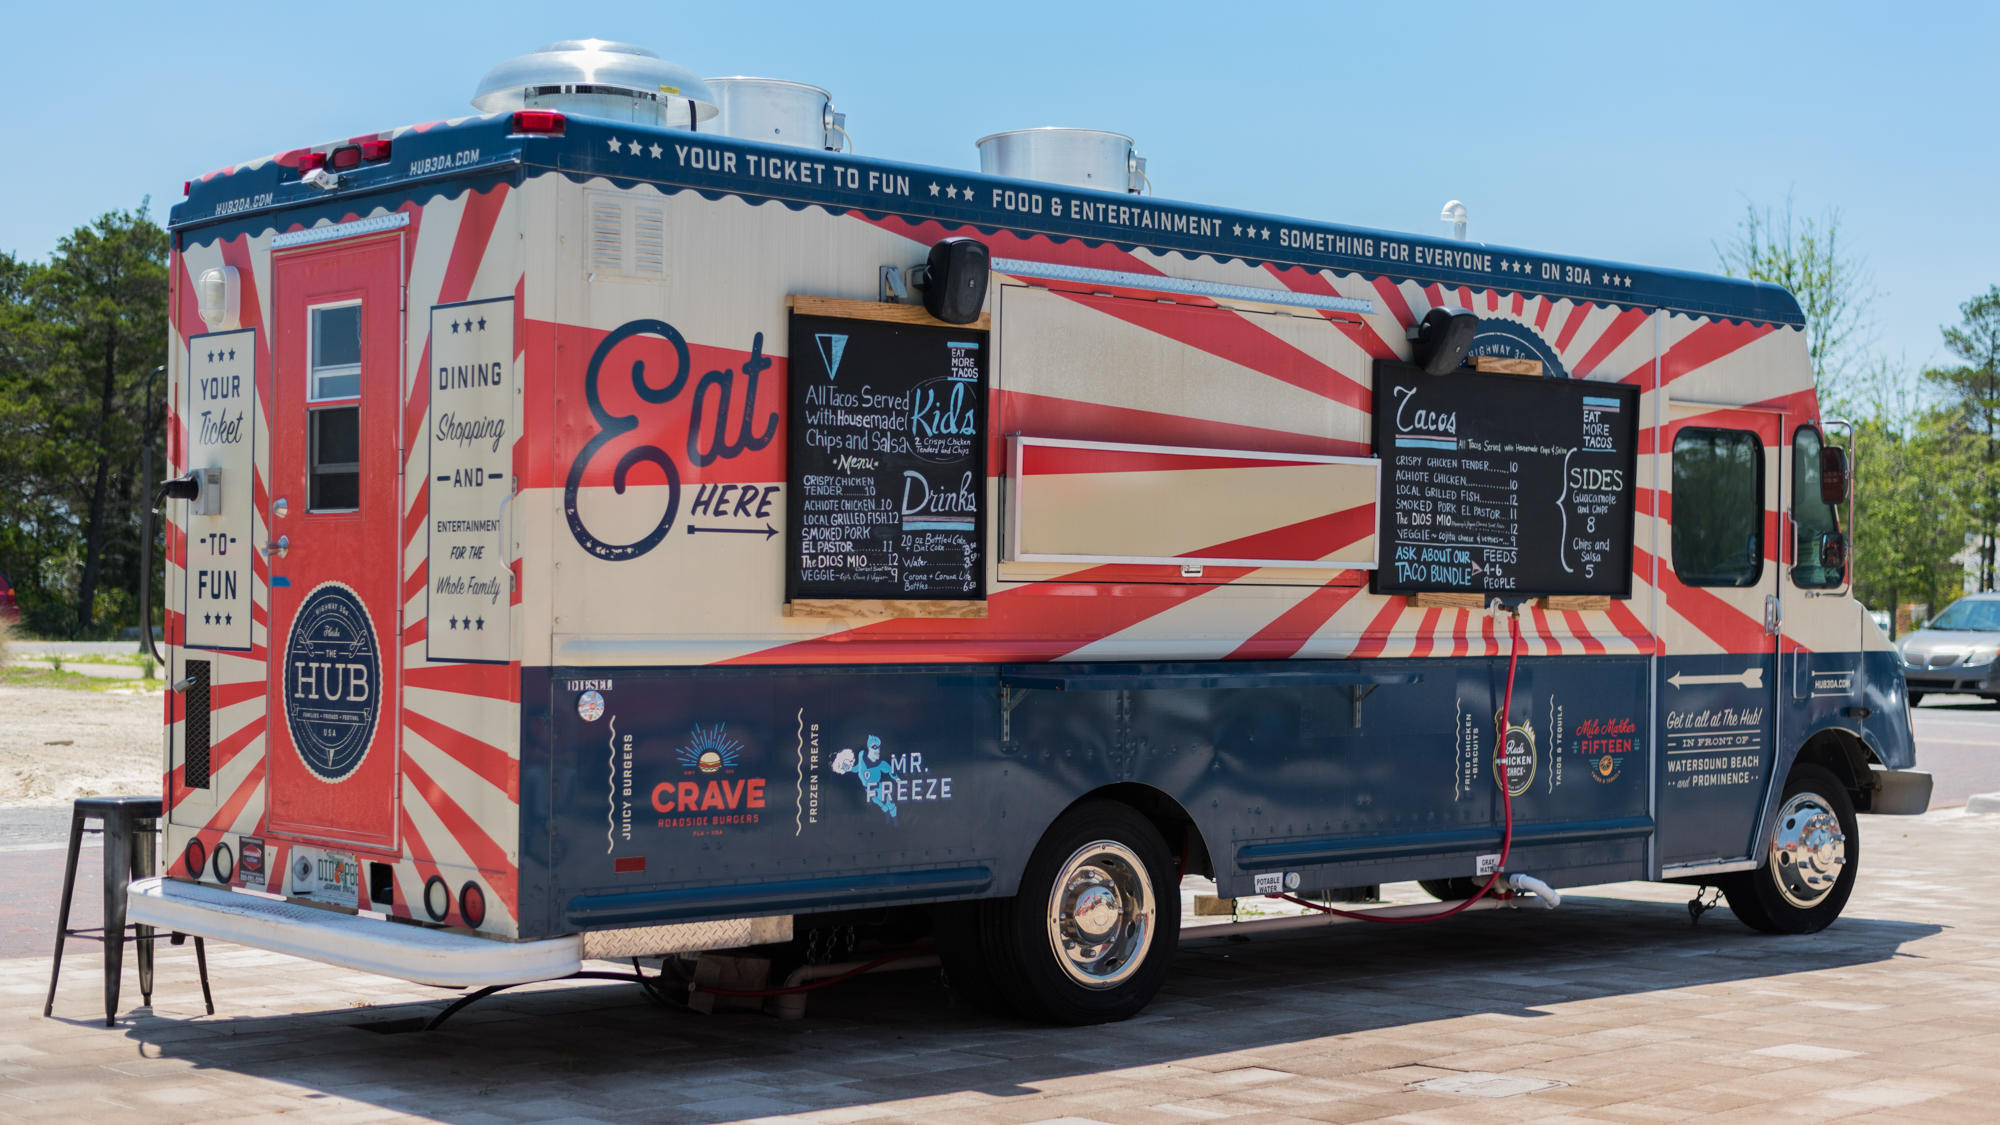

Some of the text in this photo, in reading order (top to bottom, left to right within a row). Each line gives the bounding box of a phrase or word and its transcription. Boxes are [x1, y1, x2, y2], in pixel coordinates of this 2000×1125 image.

[674, 144, 909, 196] YOUR TICKET TO FUN
[992, 188, 1223, 237] FOOD & ENTERTAINMENT
[1279, 228, 1492, 272] SOMETHING FOR EVERYONE
[1542, 262, 1592, 285] ON 30A
[951, 348, 965, 357] EAT
[951, 358, 974, 367] MORE
[439, 362, 502, 390] DINING
[951, 367, 978, 379] TACOS
[200, 375, 240, 400] YOUR
[805, 384, 909, 410] All Tacos Served
[911, 382, 977, 437] Kids
[1394, 385, 1456, 434] Tacos
[1583, 411, 1601, 423] EAT
[199, 408, 244, 445] Ticket
[837, 409, 905, 431] Housemade
[436, 411, 505, 452] Shopping
[1583, 424, 1610, 436] MORE
[564, 319, 779, 562] Eat
[806, 428, 906, 454] Chips and Salsa
[1583, 436, 1613, 449] TACOS
[838, 454, 875, 475] Menu
[1395, 456, 1518, 473] CRISPY CHICKEN TENDER 10
[454, 467, 484, 488] AND
[803, 475, 874, 486] CRISPY CHICKEN
[1395, 470, 1518, 490] ACHIOTE CHICKEN 10
[1569, 467, 1623, 491] SIDES
[803, 486, 876, 496] TENDER 10
[902, 470, 977, 515] Drinks
[1396, 485, 1518, 506] LOCAL GRILLED FISH 12
[1572, 490, 1616, 505] Guacamole
[690, 484, 781, 518] HERE
[804, 499, 892, 511] ACHIOTE CHICKEN 10
[1577, 504, 1589, 514] and
[1395, 500, 1501, 520] SMOKED PORK EL PASTOR
[437, 519, 500, 533] ENTERTAINMENT
[804, 512, 899, 526] LOCAL GRILLED FISH 12
[1396, 512, 1408, 526] The
[1412, 513, 1432, 526] DIOS
[1436, 515, 1452, 527] MIO
[1510, 524, 1518, 535] 12
[1586, 516, 1595, 533] 8
[802, 526, 871, 540] SMOKED PORK
[901, 535, 912, 546] 20
[925, 533, 952, 545] Bottled
[1397, 529, 1431, 540] VEGGIE
[209, 532, 227, 556] TO
[450, 545, 485, 560] FOR THE
[802, 541, 854, 553] EL PASTOR
[1572, 537, 1610, 551] Chips and
[801, 555, 867, 568] The DIOS MIO
[902, 556, 927, 568] Water
[1395, 546, 1470, 563] ASK ABOUT OUR
[1483, 549, 1517, 564] FEEDS
[1581, 550, 1601, 563] Salsa
[801, 569, 835, 581] VEGGIE
[891, 568, 898, 583] 9
[903, 571, 957, 582] Corona Corona
[1395, 561, 1472, 586] TACO BUNDLE
[1484, 564, 1502, 576] 4-6
[1585, 564, 1594, 578] 5
[198, 570, 237, 600] FUN
[436, 574, 501, 605] Whole Family
[904, 580, 928, 591] Bottles
[1483, 577, 1516, 589] PEOPLE
[326, 650, 337, 658] THE
[294, 662, 369, 702] HUB
[1667, 707, 1763, 730] Get it all at The Hub!
[1576, 717, 1636, 738] Mile Marker
[1581, 738, 1632, 755] FIFTEEN
[1682, 736, 1749, 748] IN FRONT OF
[891, 752, 929, 774] MR.
[1667, 755, 1759, 773] WATERSOUND BEACH
[809, 723, 819, 824] FROZEN TREATS
[1677, 771, 1750, 789] and PROMINENCE
[622, 734, 633, 840] JUICY BURGERS
[651, 778, 766, 813] CRAVE
[866, 777, 952, 803] FREEZE
[658, 813, 759, 828] ROADSIDE BURGERS
[1256, 876, 1280, 886] POTABLE
[1259, 885, 1277, 893] WATER
